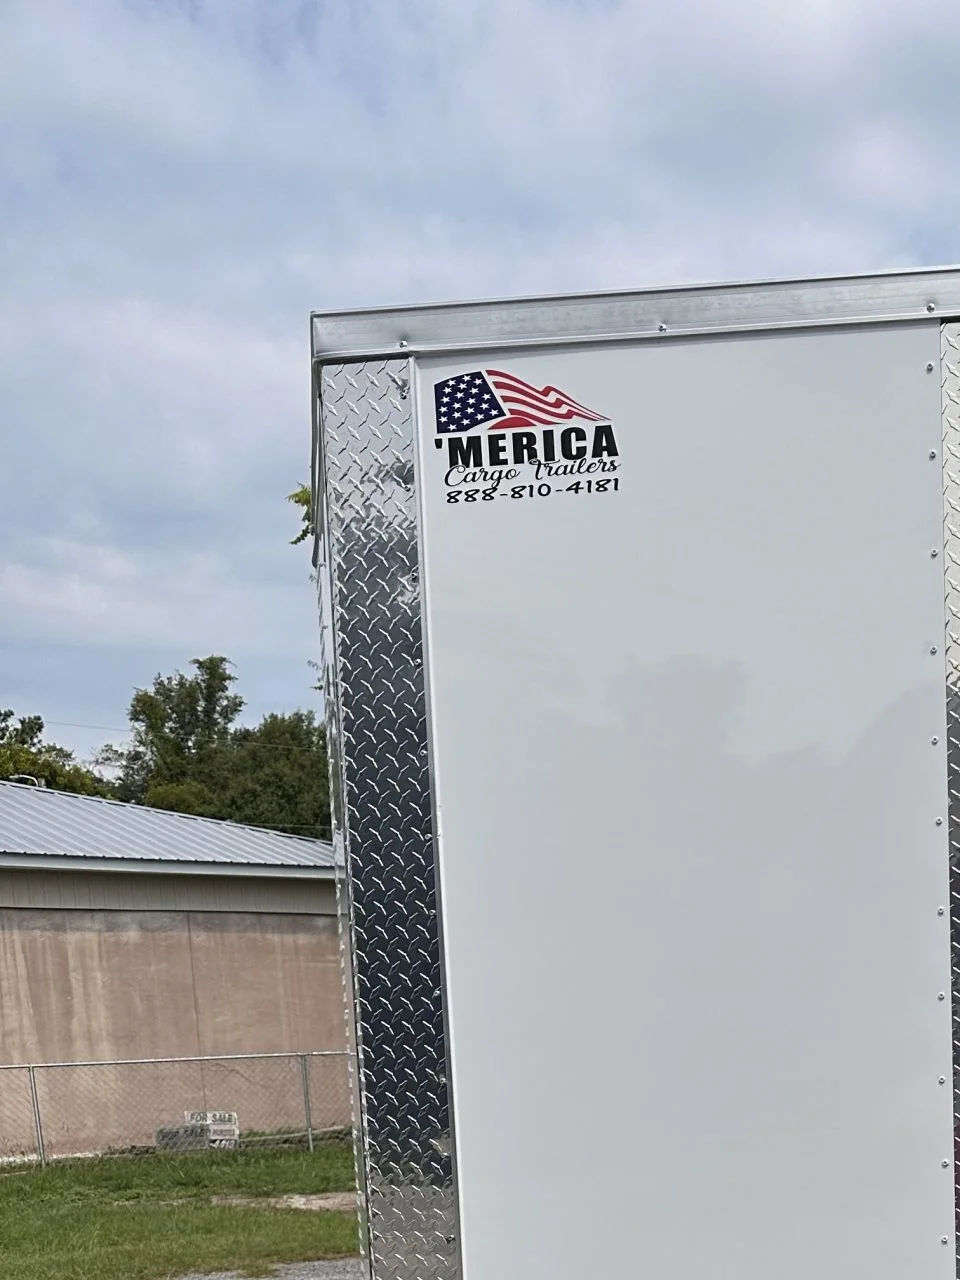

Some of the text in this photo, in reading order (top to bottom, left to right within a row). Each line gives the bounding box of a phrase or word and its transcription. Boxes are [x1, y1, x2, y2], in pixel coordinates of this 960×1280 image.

[434, 424, 619, 469] 'MERICA
[444, 457, 622, 488] Cargo Trailers
[446, 478, 619, 504] 888-810-4181
[190, 1112, 233, 1123] FOR SALE
